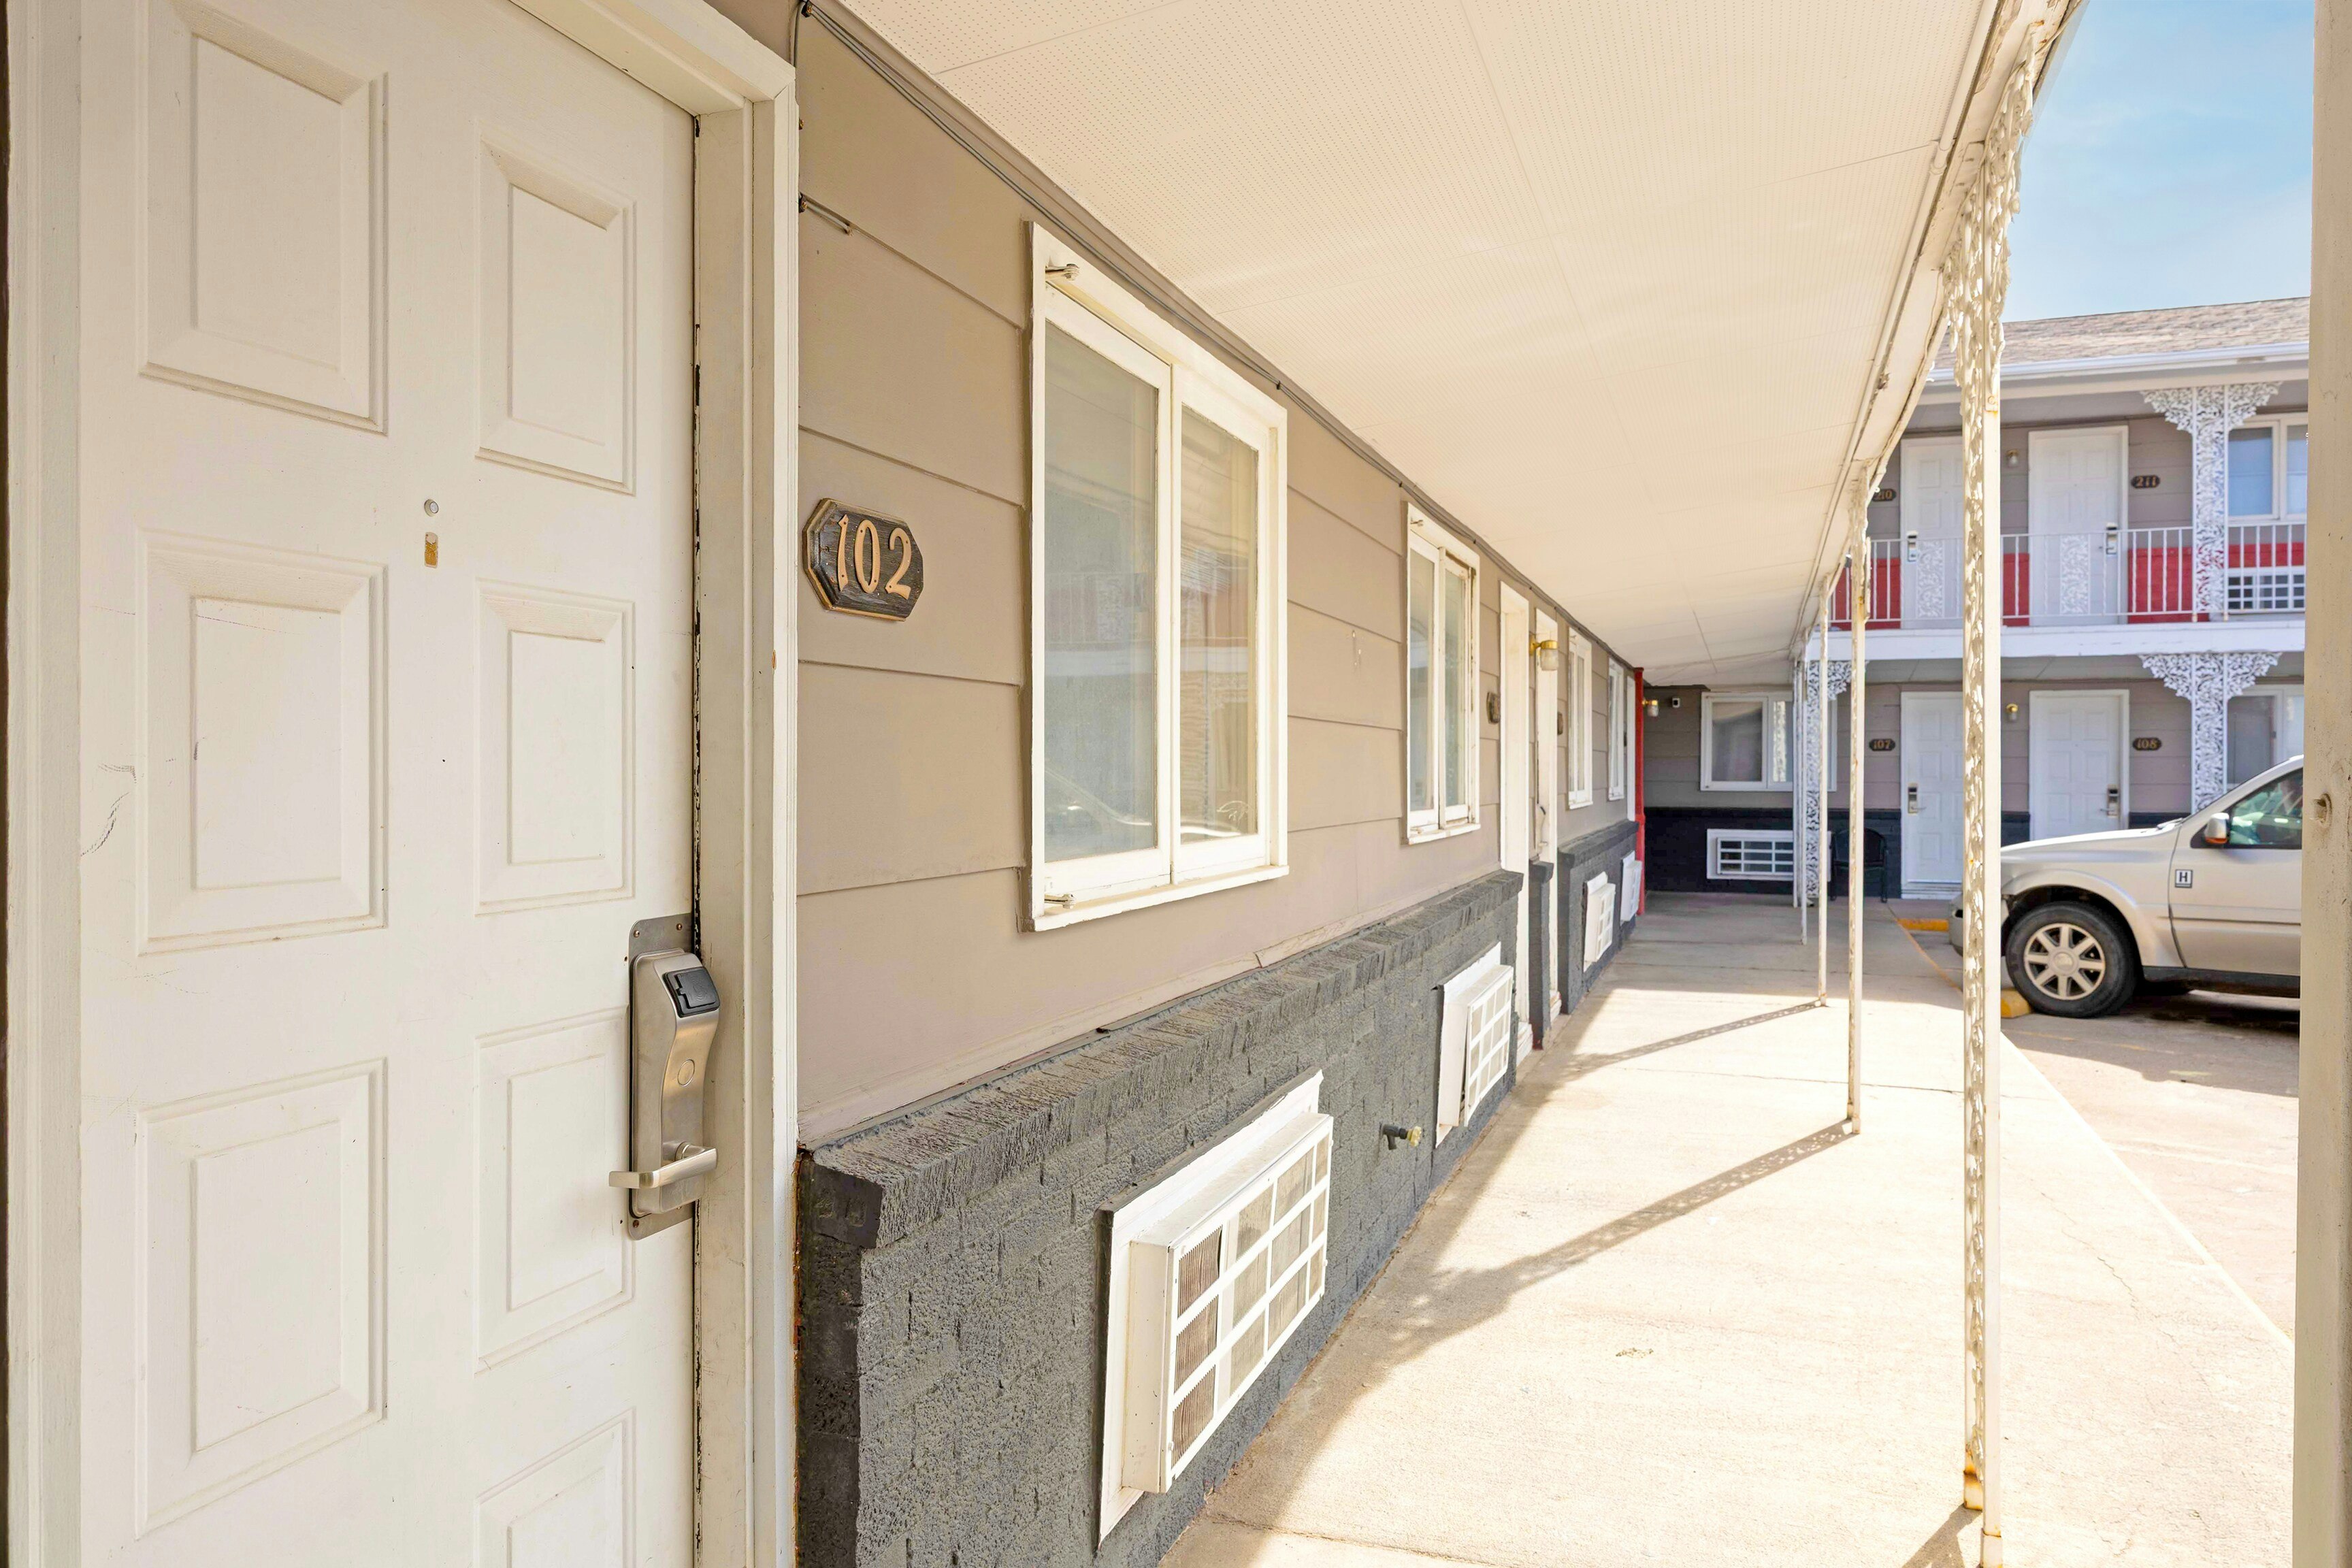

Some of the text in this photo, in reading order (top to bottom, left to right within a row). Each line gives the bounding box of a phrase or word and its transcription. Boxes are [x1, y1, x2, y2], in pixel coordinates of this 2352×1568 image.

[2136, 475, 2157, 487] 211
[837, 514, 912, 600] 102
[1873, 740, 1891, 749] 107
[2137, 738, 2157, 749] 108
[2179, 871, 2188, 882] H
